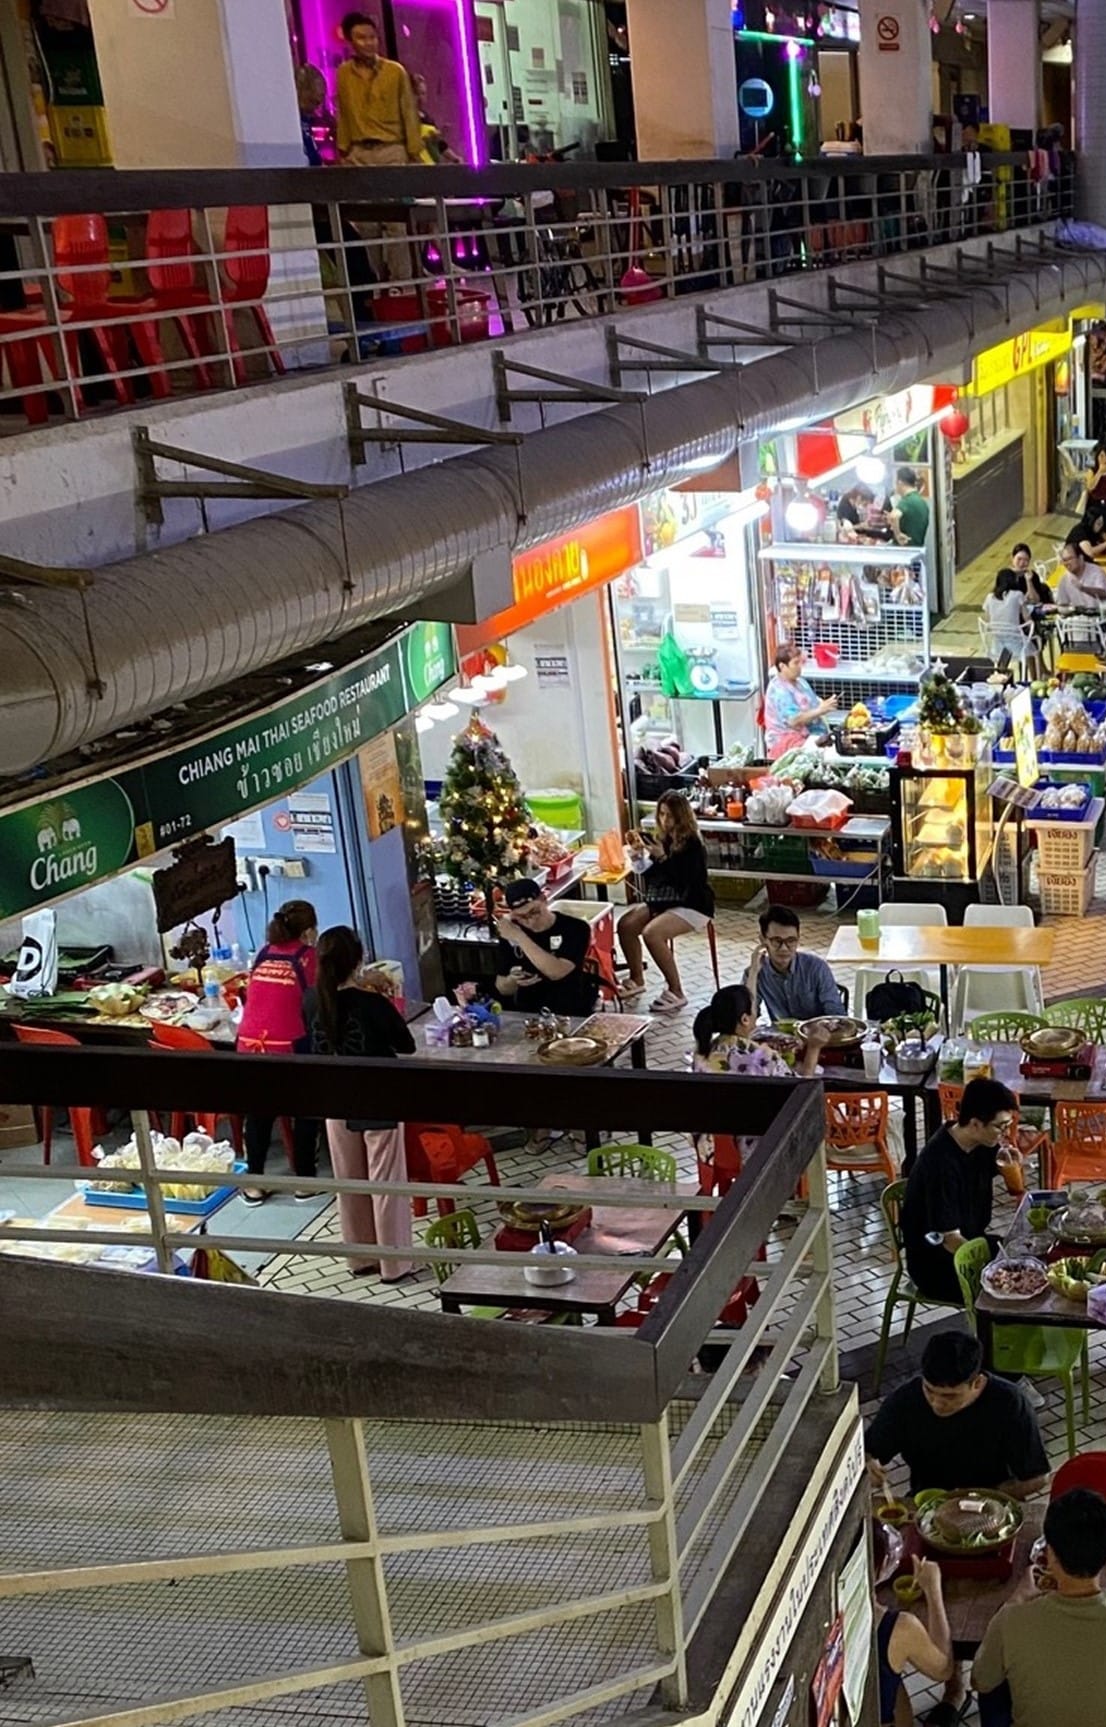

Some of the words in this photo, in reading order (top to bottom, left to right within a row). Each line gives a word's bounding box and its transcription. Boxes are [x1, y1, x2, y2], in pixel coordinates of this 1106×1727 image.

[178, 749, 234, 785] CHIANG
[236, 737, 261, 762] MAI
[262, 724, 290, 749] THAI
[291, 695, 338, 735] SEAFOOD
[340, 663, 391, 707] RESTAURANT
[236, 763, 303, 799] ข้าวซอย
[307, 705, 361, 766] เชียงใหม่
[159, 814, 192, 837] #01-72
[30, 846, 98, 890] Chang
